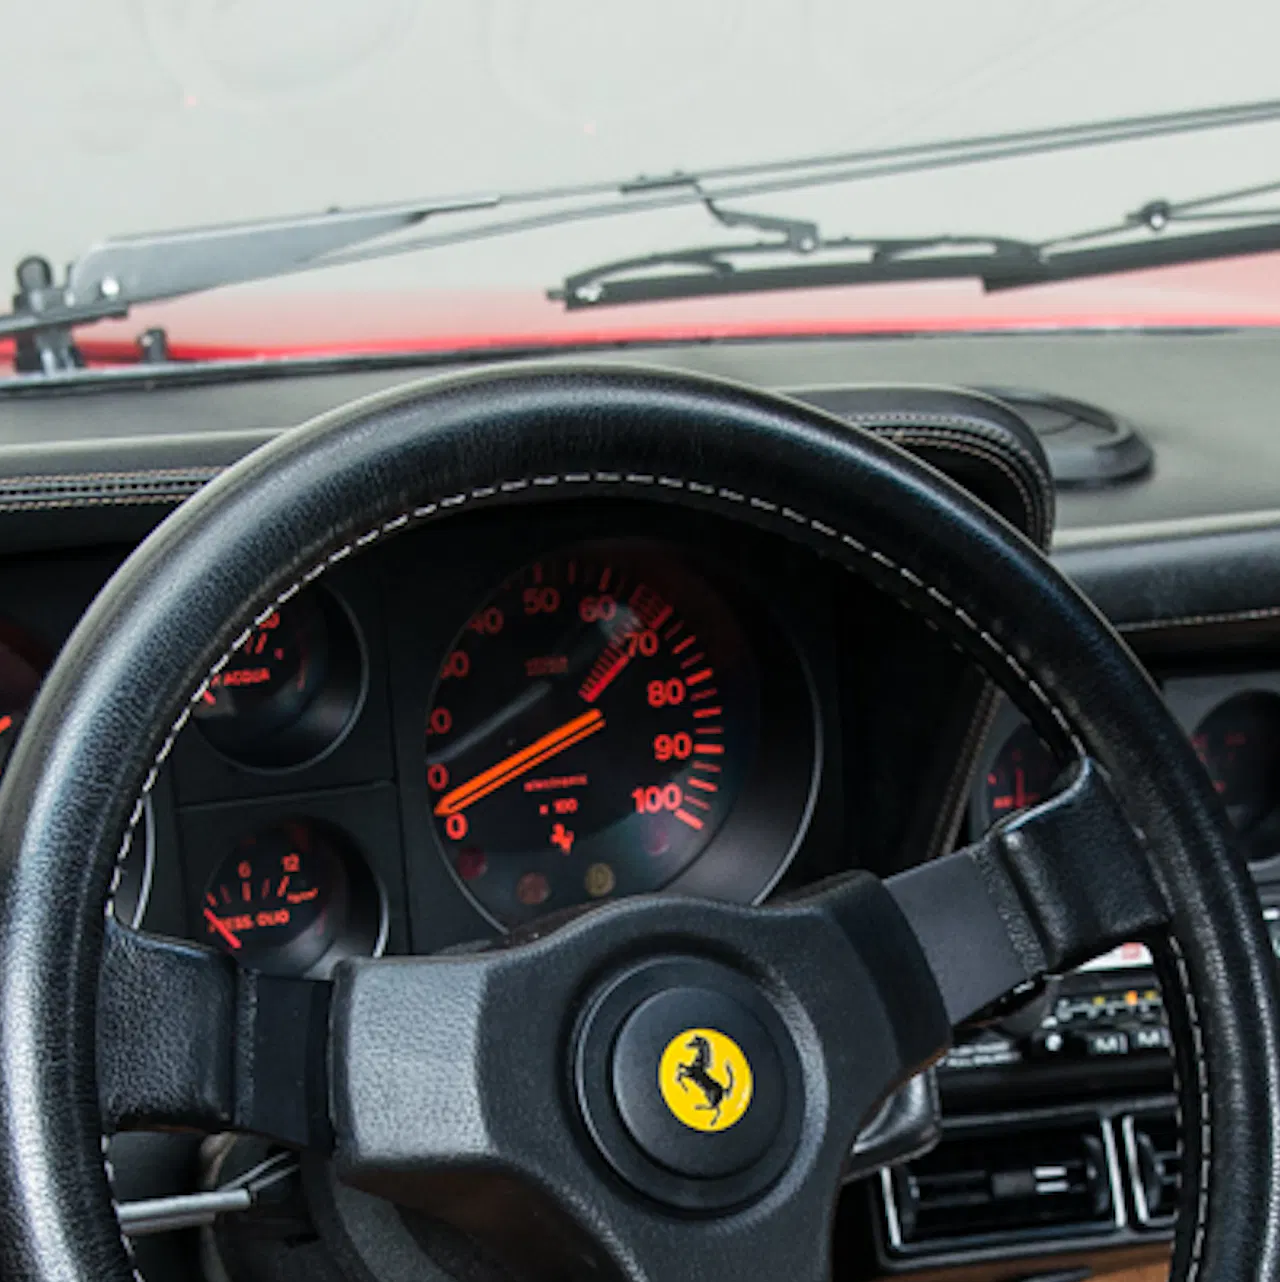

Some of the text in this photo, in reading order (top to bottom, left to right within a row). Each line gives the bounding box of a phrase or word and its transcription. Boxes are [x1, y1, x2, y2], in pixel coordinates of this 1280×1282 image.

[523, 587, 561, 615] 50
[578, 594, 616, 623] 60
[625, 630, 660, 658] 70
[646, 677, 687, 709] 80
[653, 731, 694, 762] 90
[632, 782, 683, 815] 100
[445, 812, 469, 841] 0
